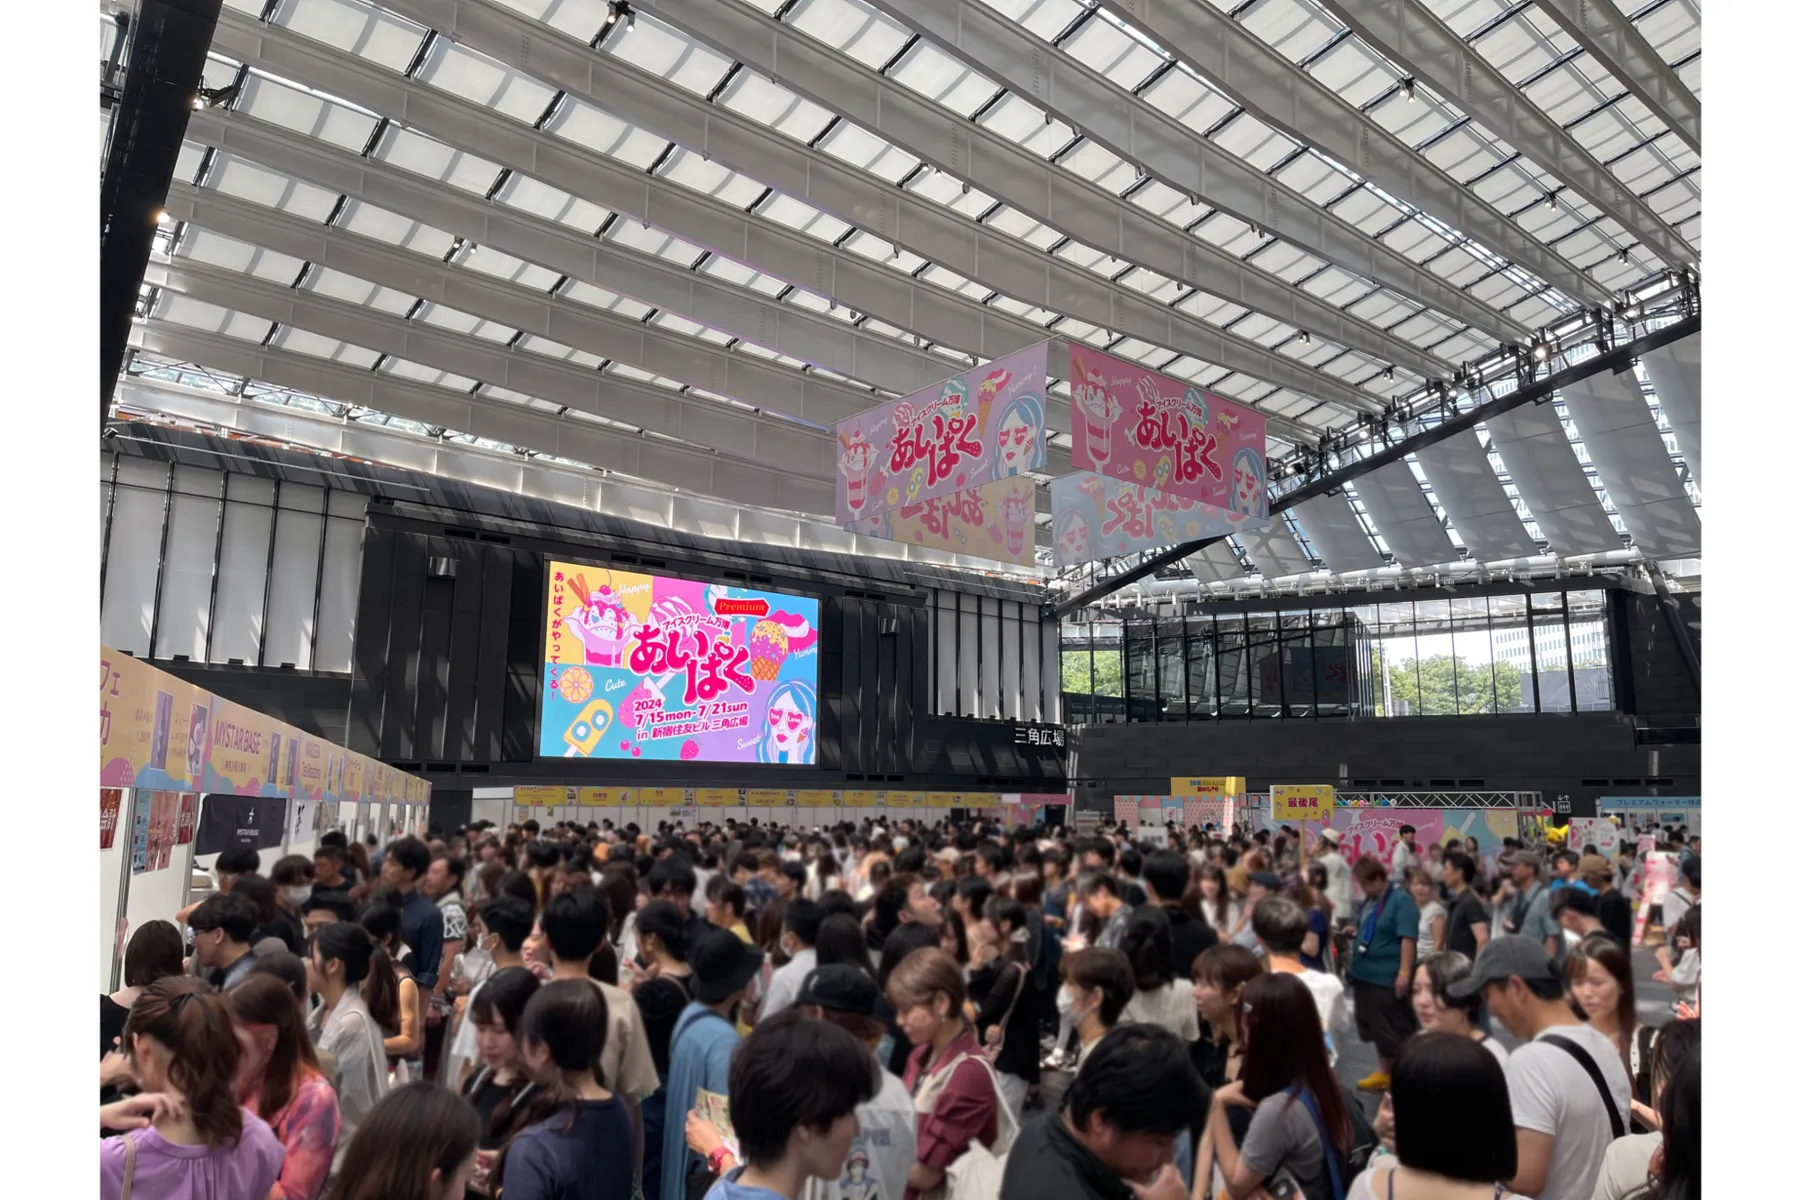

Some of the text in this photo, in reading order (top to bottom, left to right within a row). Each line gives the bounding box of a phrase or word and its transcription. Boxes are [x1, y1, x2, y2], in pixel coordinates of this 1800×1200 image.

[1136, 401, 1222, 483] あいぱく
[890, 414, 982, 487] あいぱく
[618, 582, 650, 596] Happy
[719, 601, 765, 612] Premium
[663, 614, 731, 631] アイスクリーム万博
[629, 623, 755, 705] あいぱく
[605, 677, 627, 692] Cute
[634, 699, 662, 711] 2024
[214, 720, 244, 752] MYSTAR
[243, 730, 261, 755] BASE
[637, 730, 648, 740] in
[1014, 727, 1065, 747] 三角広場
[1287, 796, 1320, 808] 最後尾
